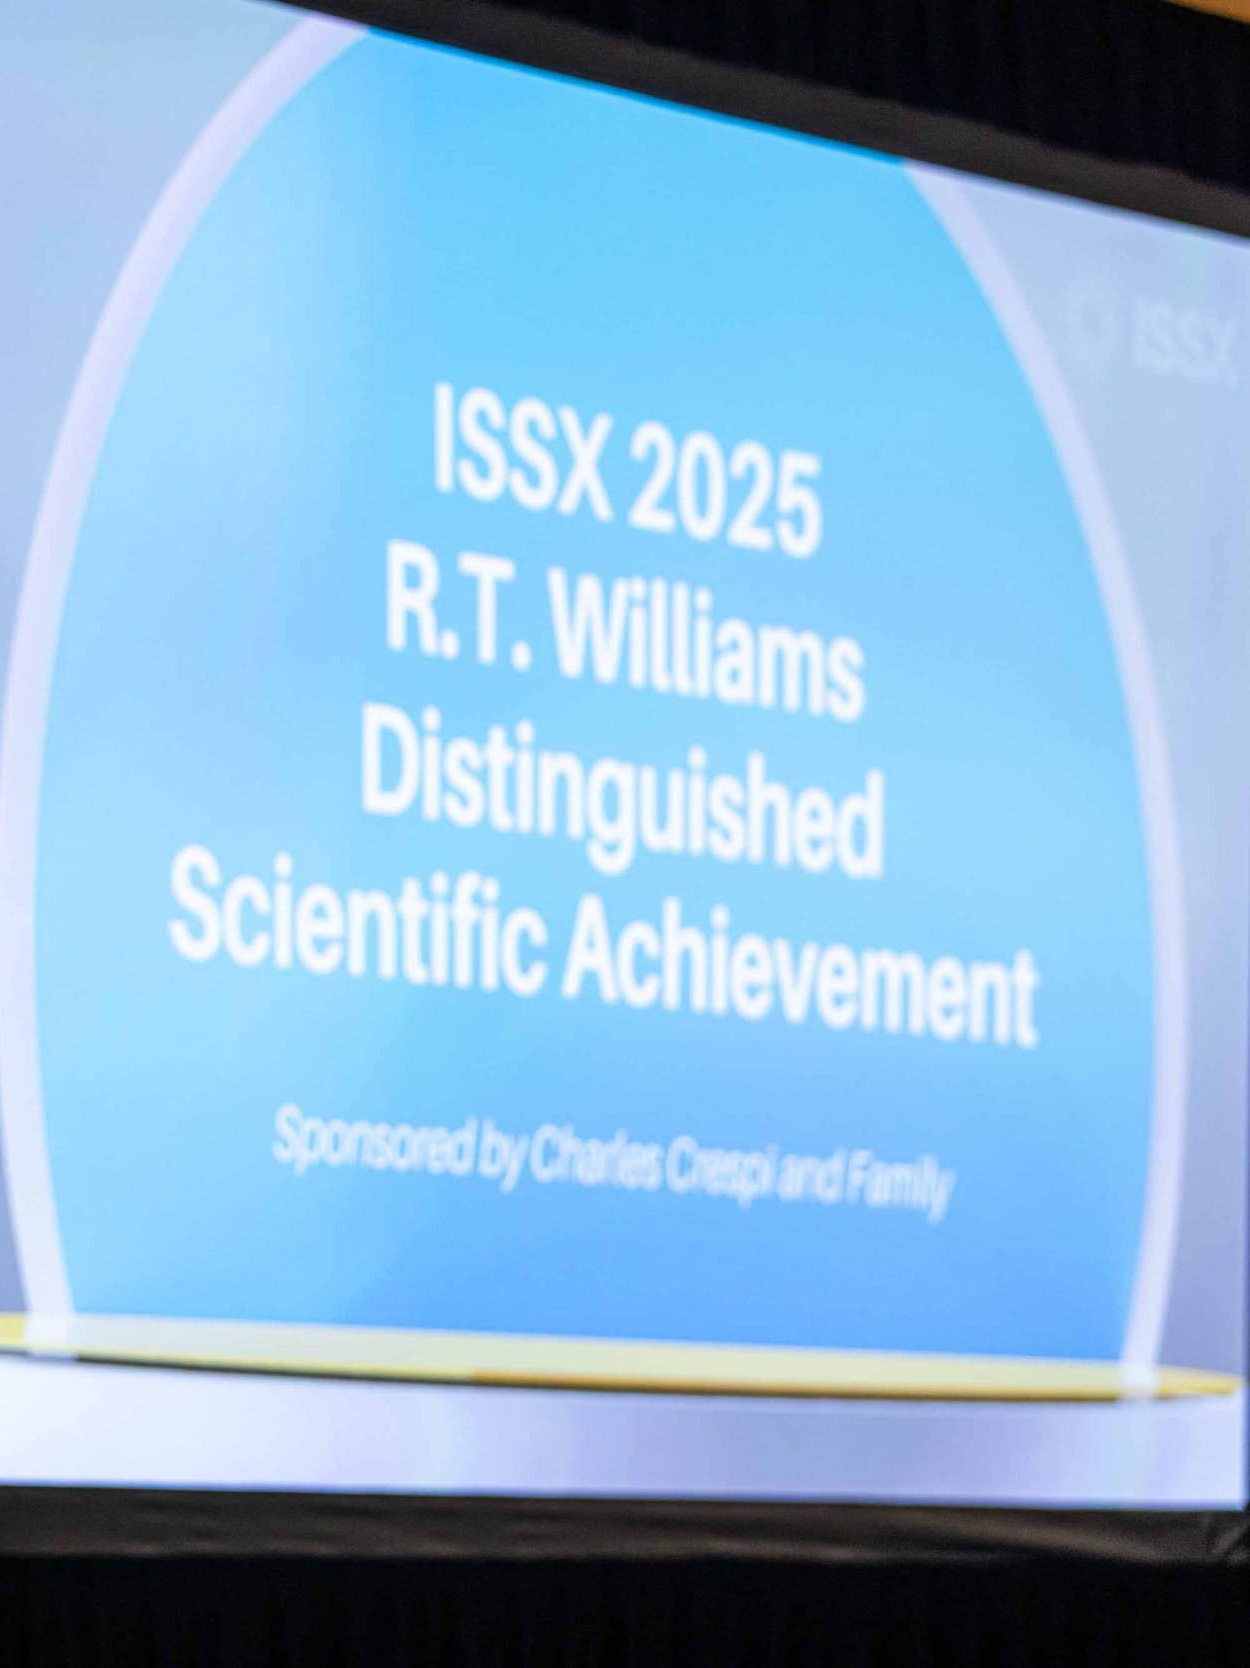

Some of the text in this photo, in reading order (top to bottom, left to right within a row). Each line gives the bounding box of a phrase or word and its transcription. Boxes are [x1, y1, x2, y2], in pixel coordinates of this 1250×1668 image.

[435, 381, 823, 559] ISSX 2025
[385, 538, 867, 723] R.T. Williams
[360, 701, 885, 880] Distinguished
[167, 844, 1040, 1050] Scientific Achievement
[271, 1101, 479, 1177] Sponsored
[478, 1114, 530, 1195] by
[530, 1120, 664, 1194] Charles
[776, 1145, 848, 1206] and
[847, 1148, 959, 1226] Family
